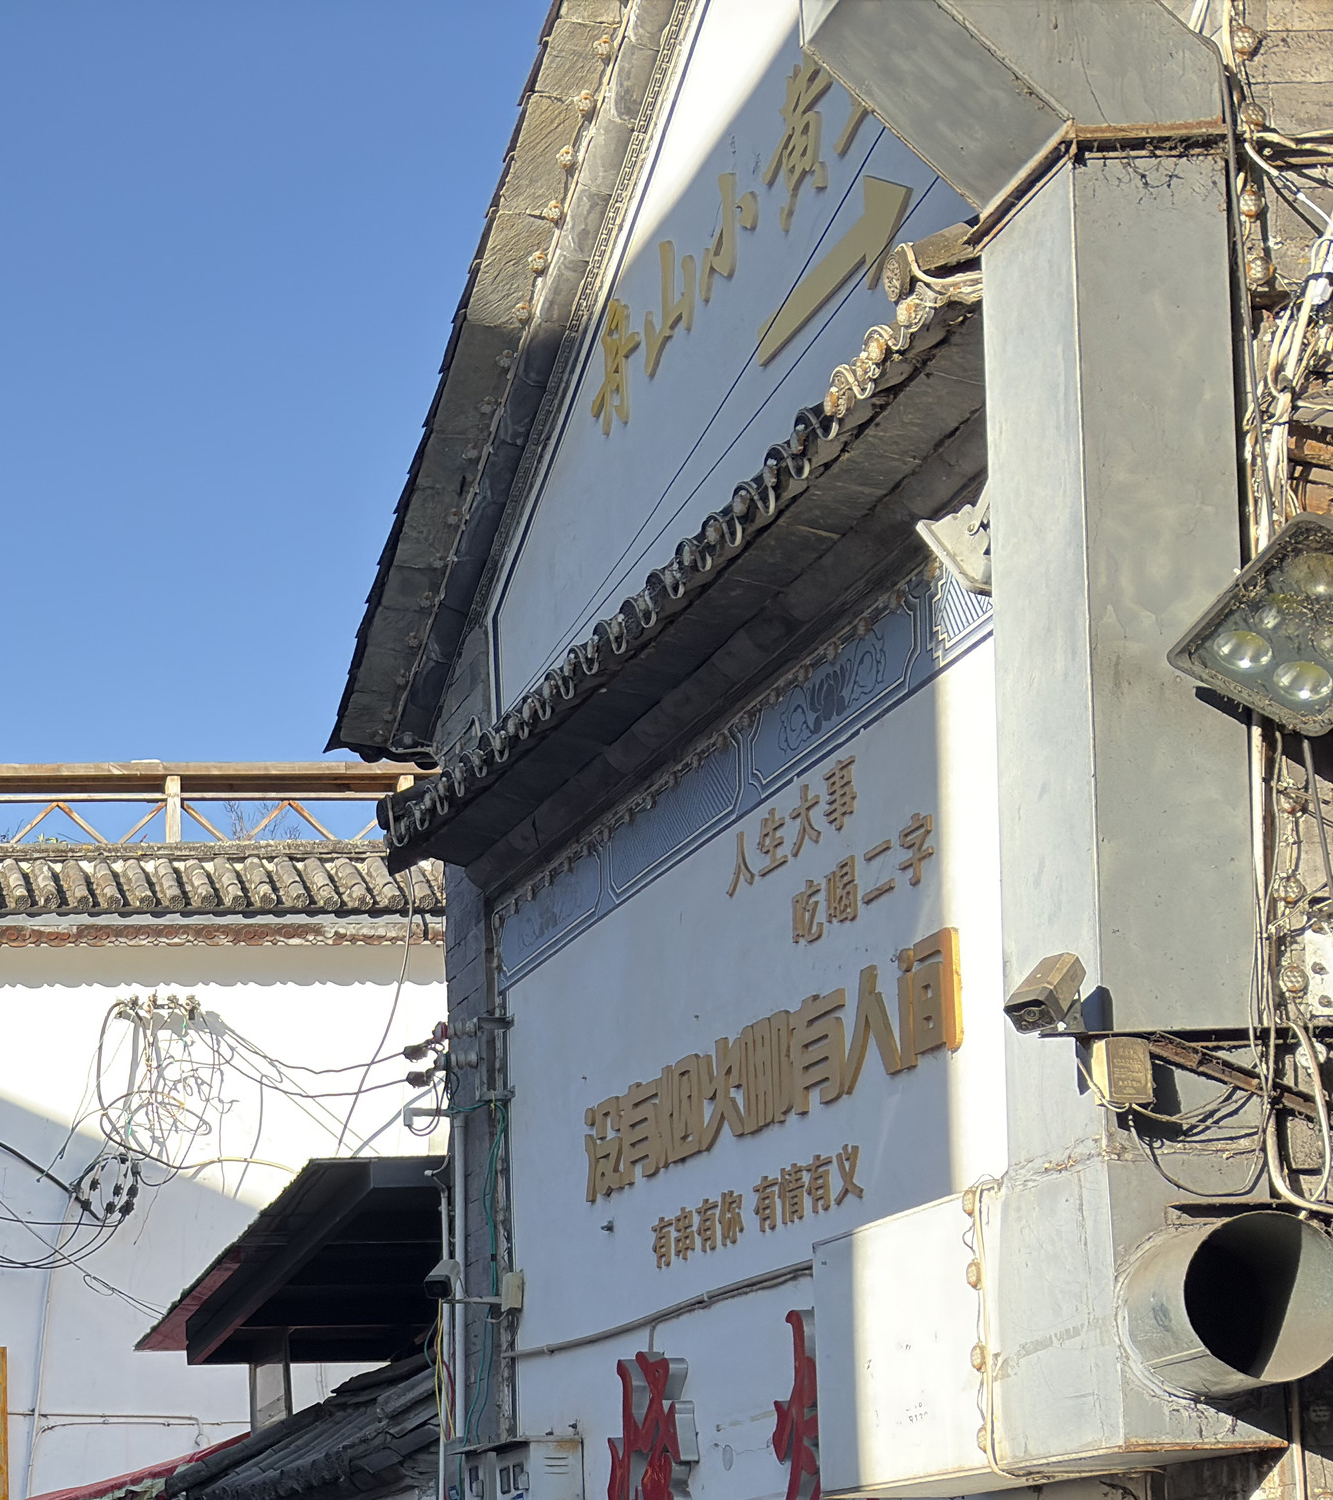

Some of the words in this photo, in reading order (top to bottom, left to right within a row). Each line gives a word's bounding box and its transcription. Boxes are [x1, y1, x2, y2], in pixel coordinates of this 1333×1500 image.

[726, 755, 857, 897] 人生大事
[792, 812, 935, 944] 吃喝二字
[584, 926, 963, 1204] 没有烟火哪有人间
[651, 1190, 745, 1269] 有串有你
[753, 1143, 864, 1233] 有情有义
